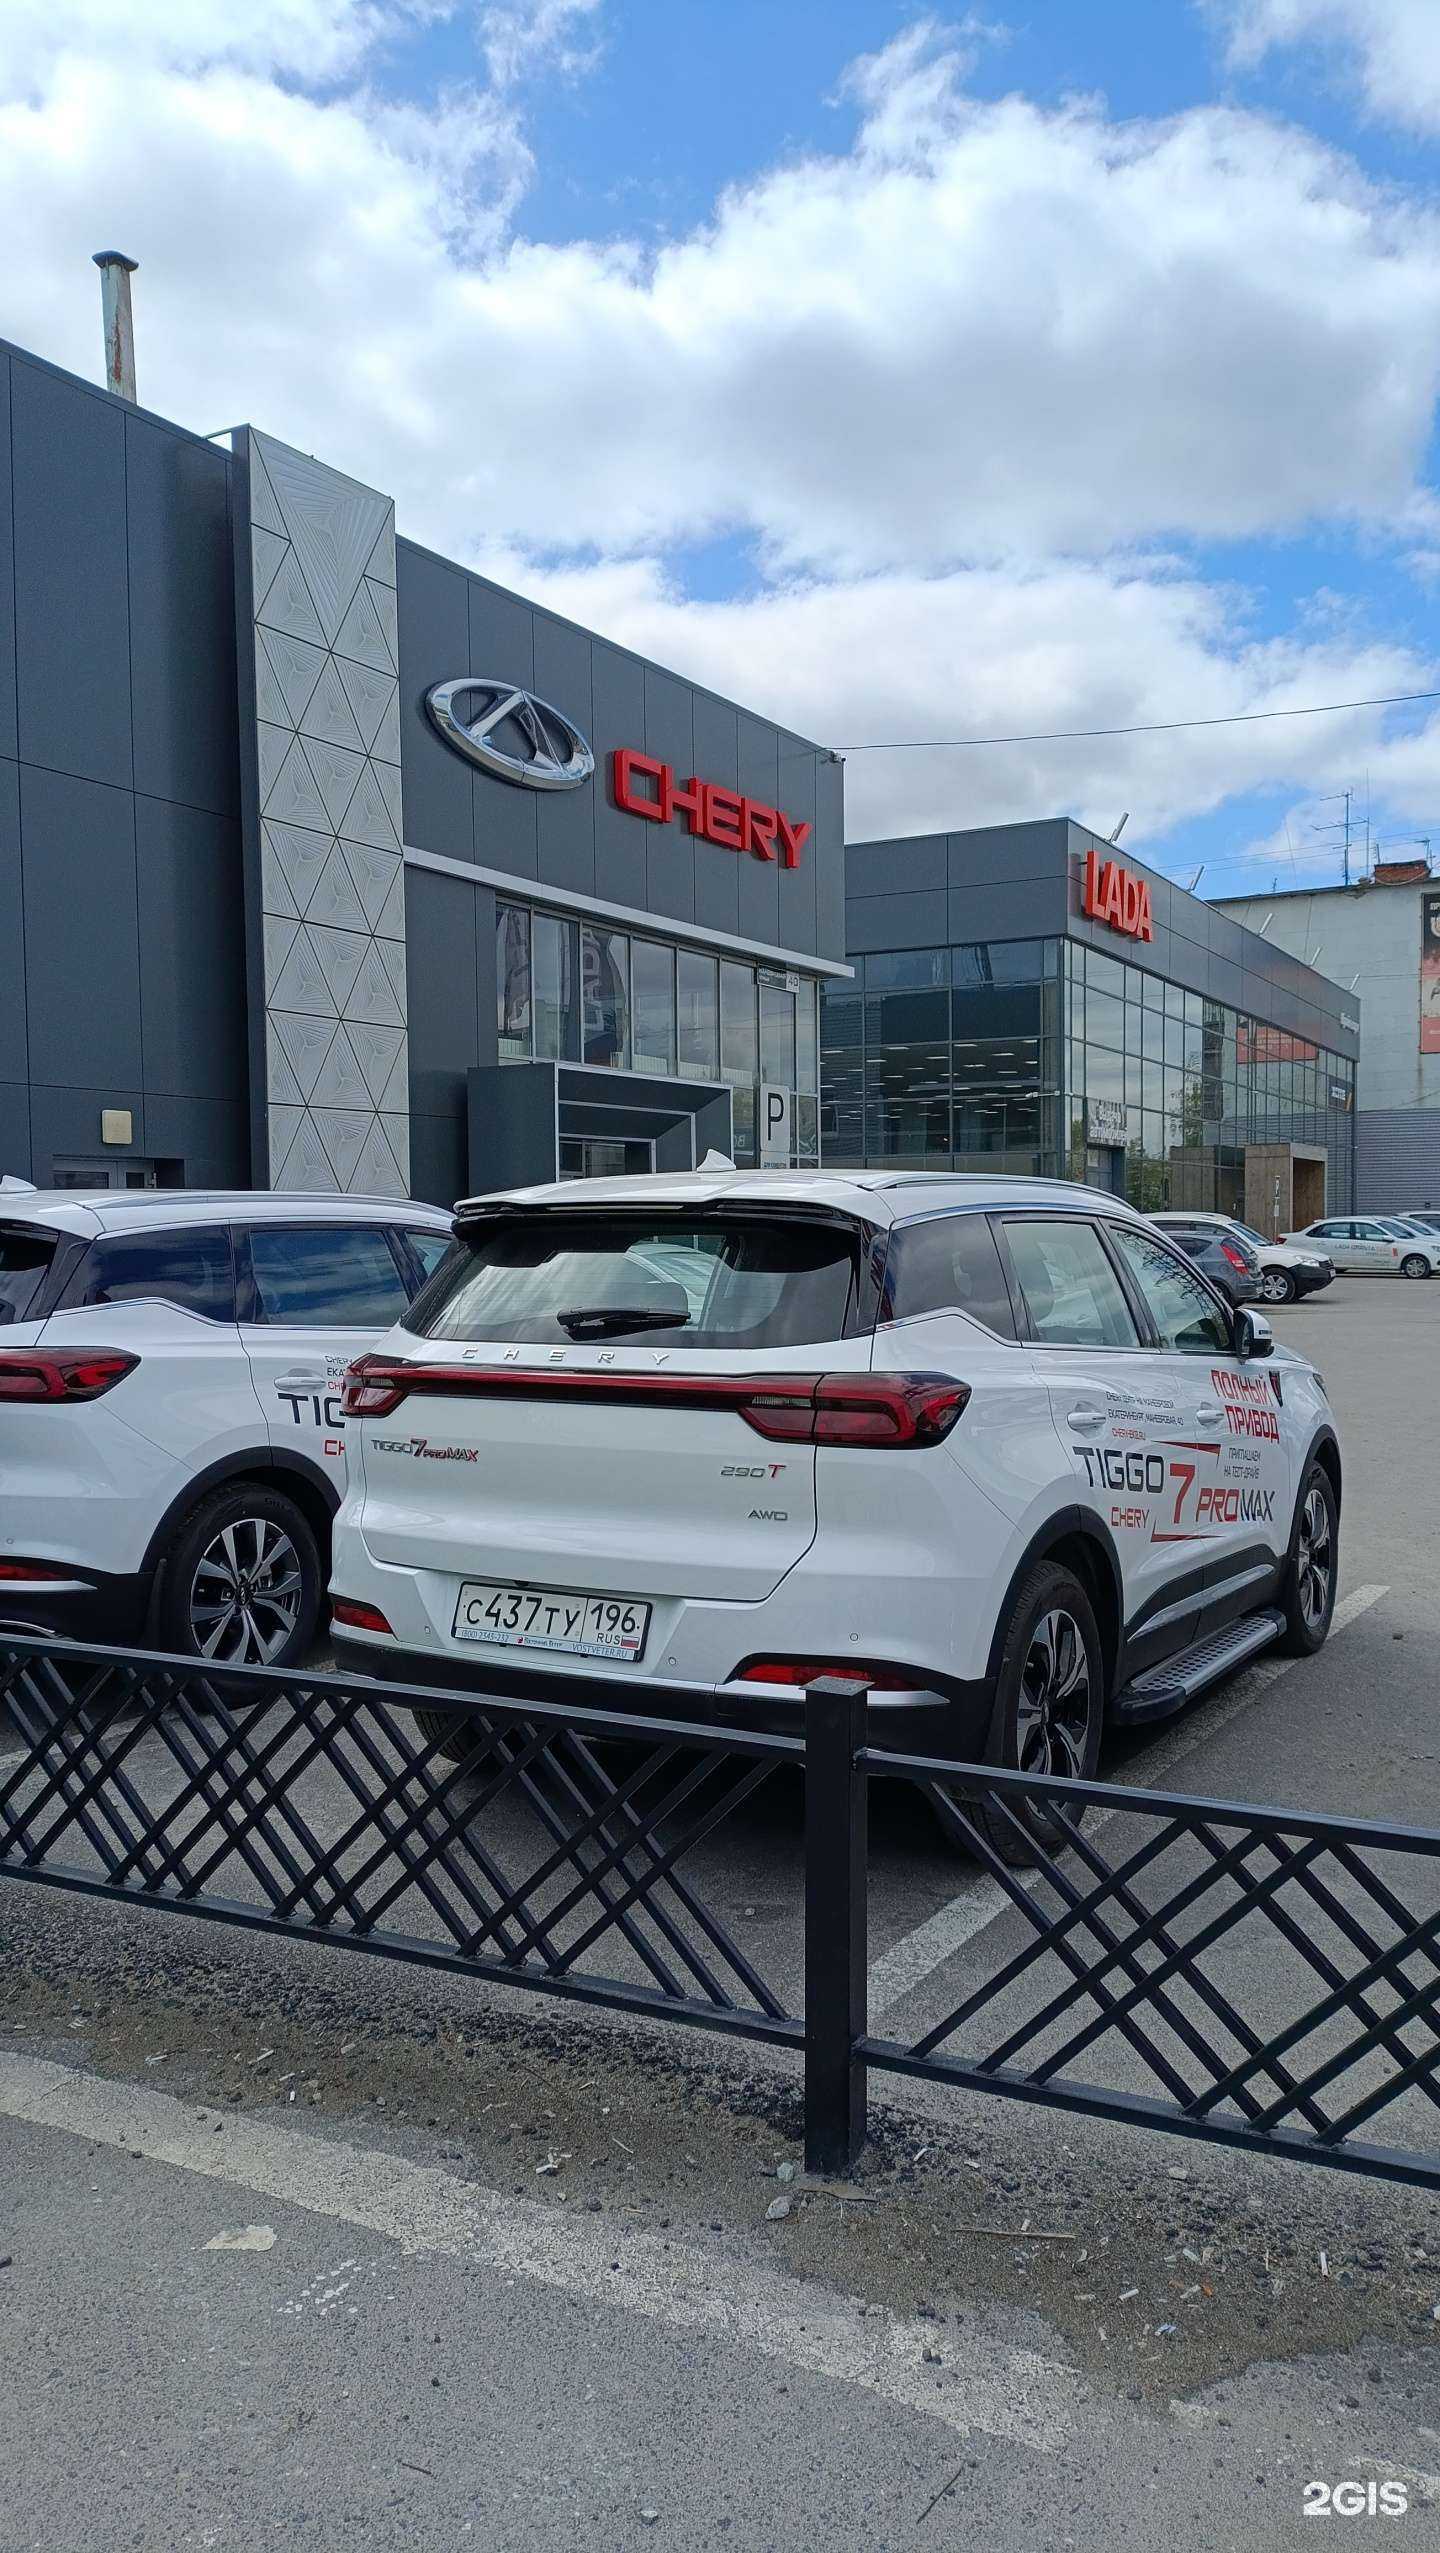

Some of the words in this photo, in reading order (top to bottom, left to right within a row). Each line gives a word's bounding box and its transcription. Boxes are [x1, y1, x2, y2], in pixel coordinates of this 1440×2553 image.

[614, 749, 812, 868] CHERY
[1086, 851, 1152, 943] LADA
[462, 1346, 669, 1366] CHERY
[1211, 1369, 1273, 1407] ПОЛНЫЙ
[1224, 1404, 1280, 1444] ПРИВОД
[1072, 1445, 1164, 1494] TIGGO
[1169, 1463, 1196, 1524] 7
[748, 1509, 788, 1521] AWD
[1111, 1506, 1149, 1528] CHERY
[590, 1602, 637, 1634] 196
[572, 1643, 628, 1658] VOSTVETER.RU
[596, 1632, 621, 1645] RUS
